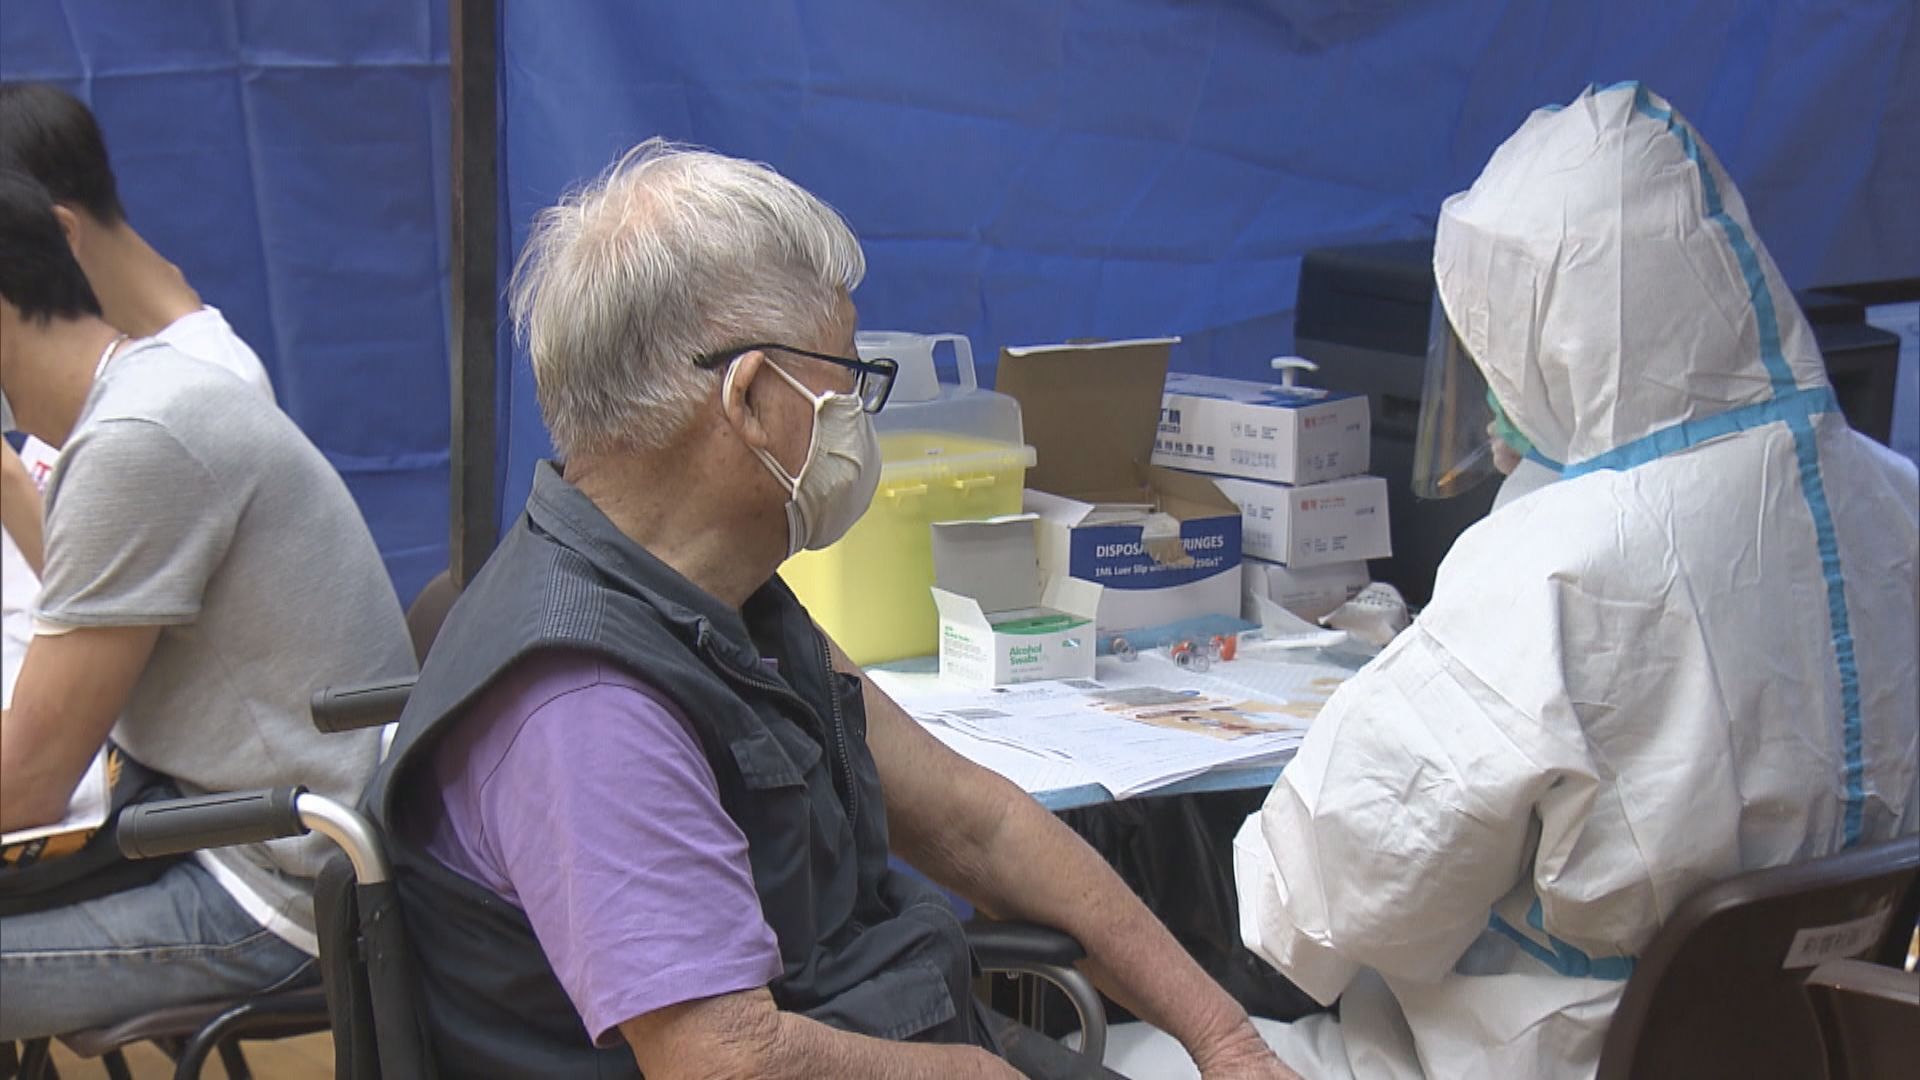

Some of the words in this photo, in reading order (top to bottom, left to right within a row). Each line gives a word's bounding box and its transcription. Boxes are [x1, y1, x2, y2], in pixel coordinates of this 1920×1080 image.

[1181, 535, 1224, 551] RINGES
[1009, 643, 1042, 656] Alcohol
[1009, 654, 1038, 665] Swabs
